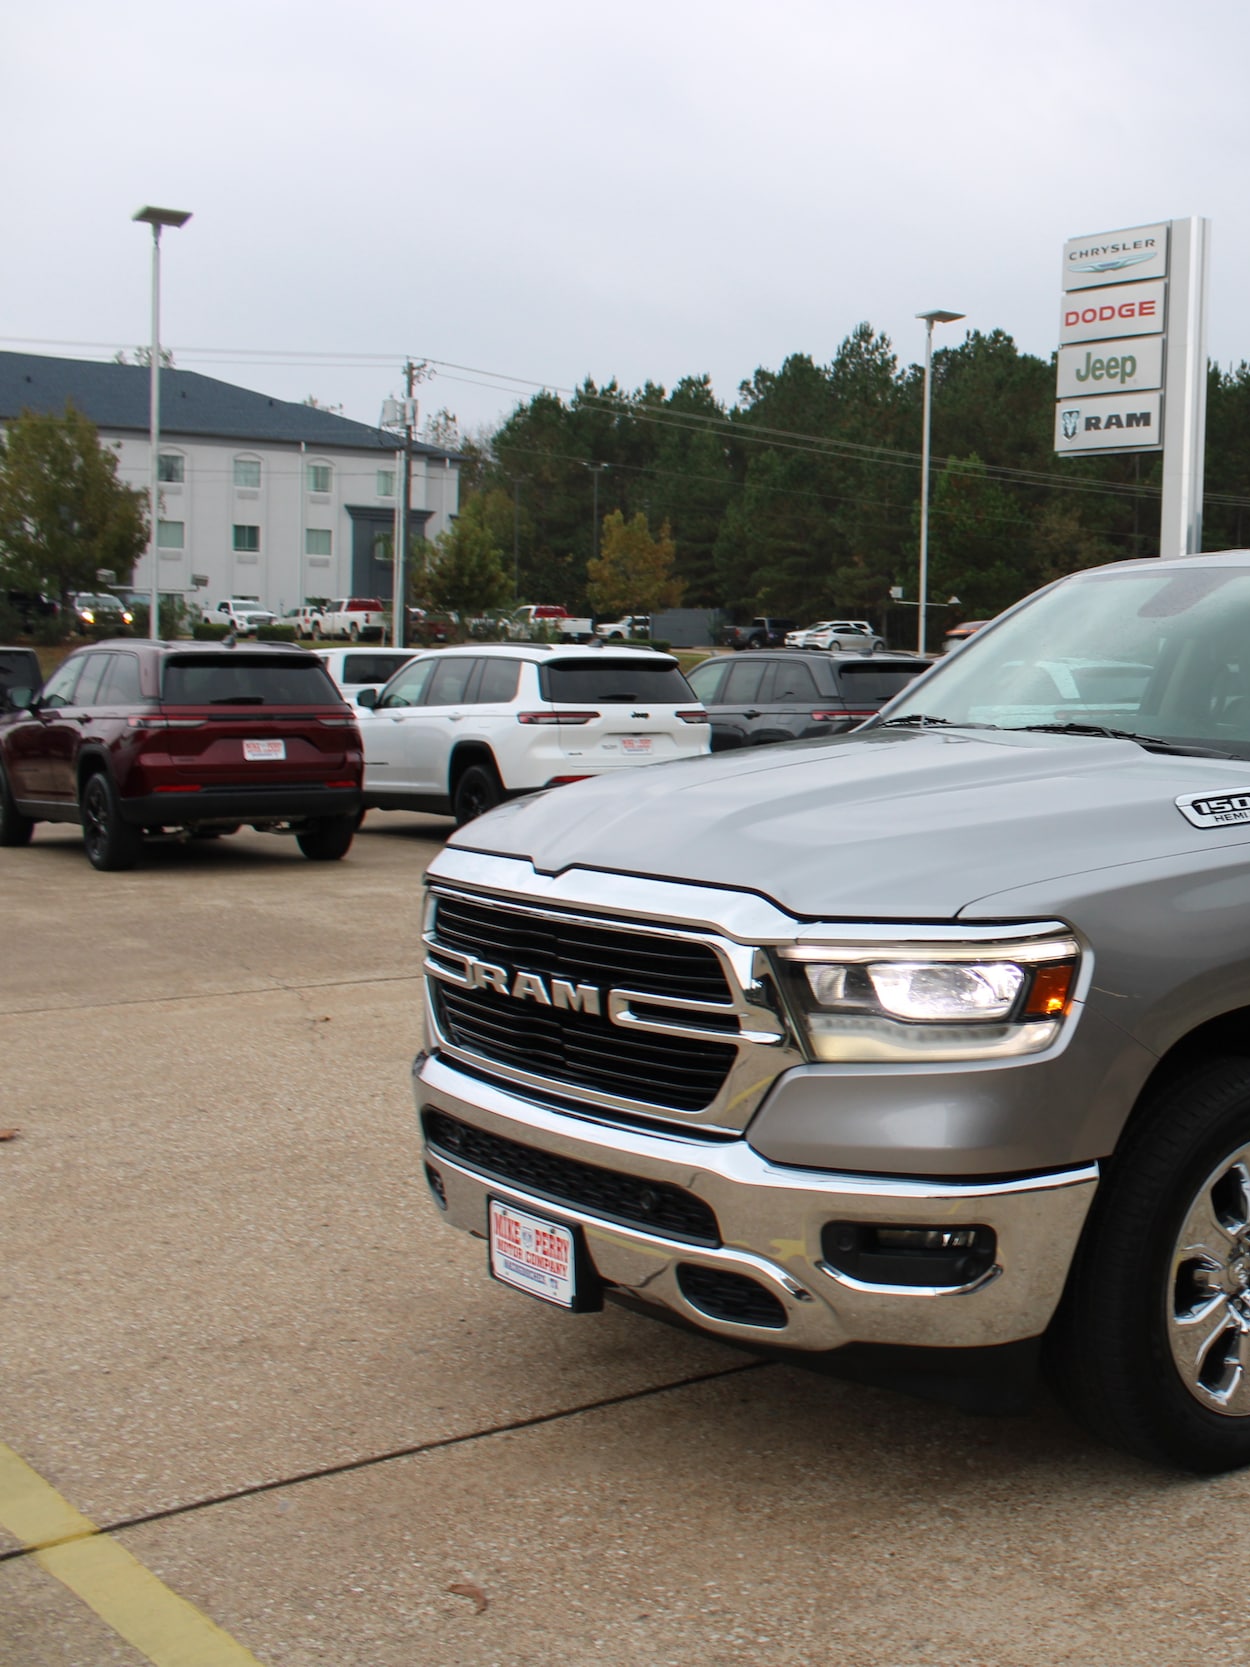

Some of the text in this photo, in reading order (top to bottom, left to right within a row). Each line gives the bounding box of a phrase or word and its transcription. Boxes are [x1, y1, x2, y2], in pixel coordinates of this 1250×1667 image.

[1069, 238, 1156, 261] CHRYSLER
[1064, 300, 1156, 327] DODGE
[1076, 352, 1137, 384] Jeep
[1084, 411, 1152, 432] RAM
[631, 711, 649, 719] Jeep
[1214, 811, 1248, 822] HEMI
[473, 960, 601, 1016] RAM
